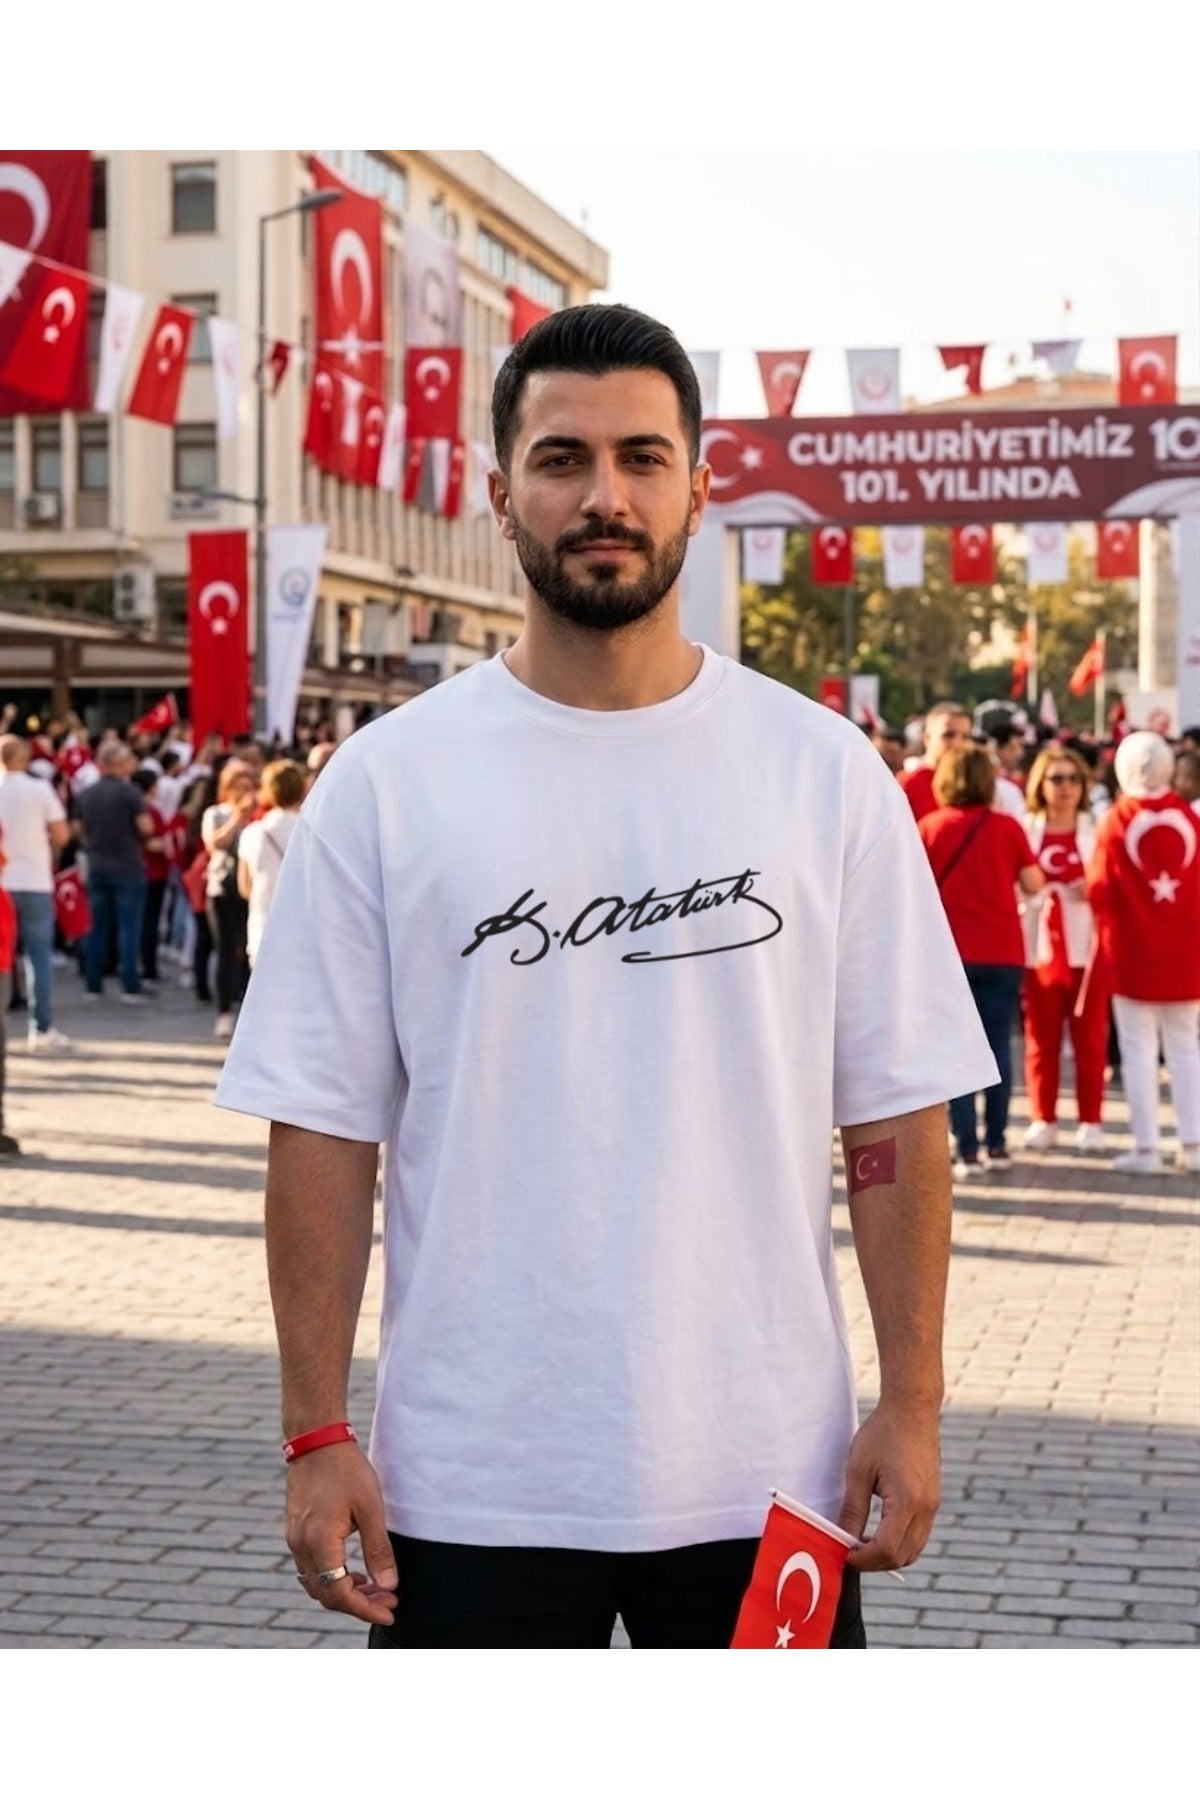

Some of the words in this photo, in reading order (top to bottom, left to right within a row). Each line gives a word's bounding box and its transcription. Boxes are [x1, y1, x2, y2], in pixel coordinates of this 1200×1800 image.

[788, 416, 1134, 465] CUMHURİYETİMİZ
[841, 470, 908, 502] 101.
[918, 466, 1080, 500] YILINDA
